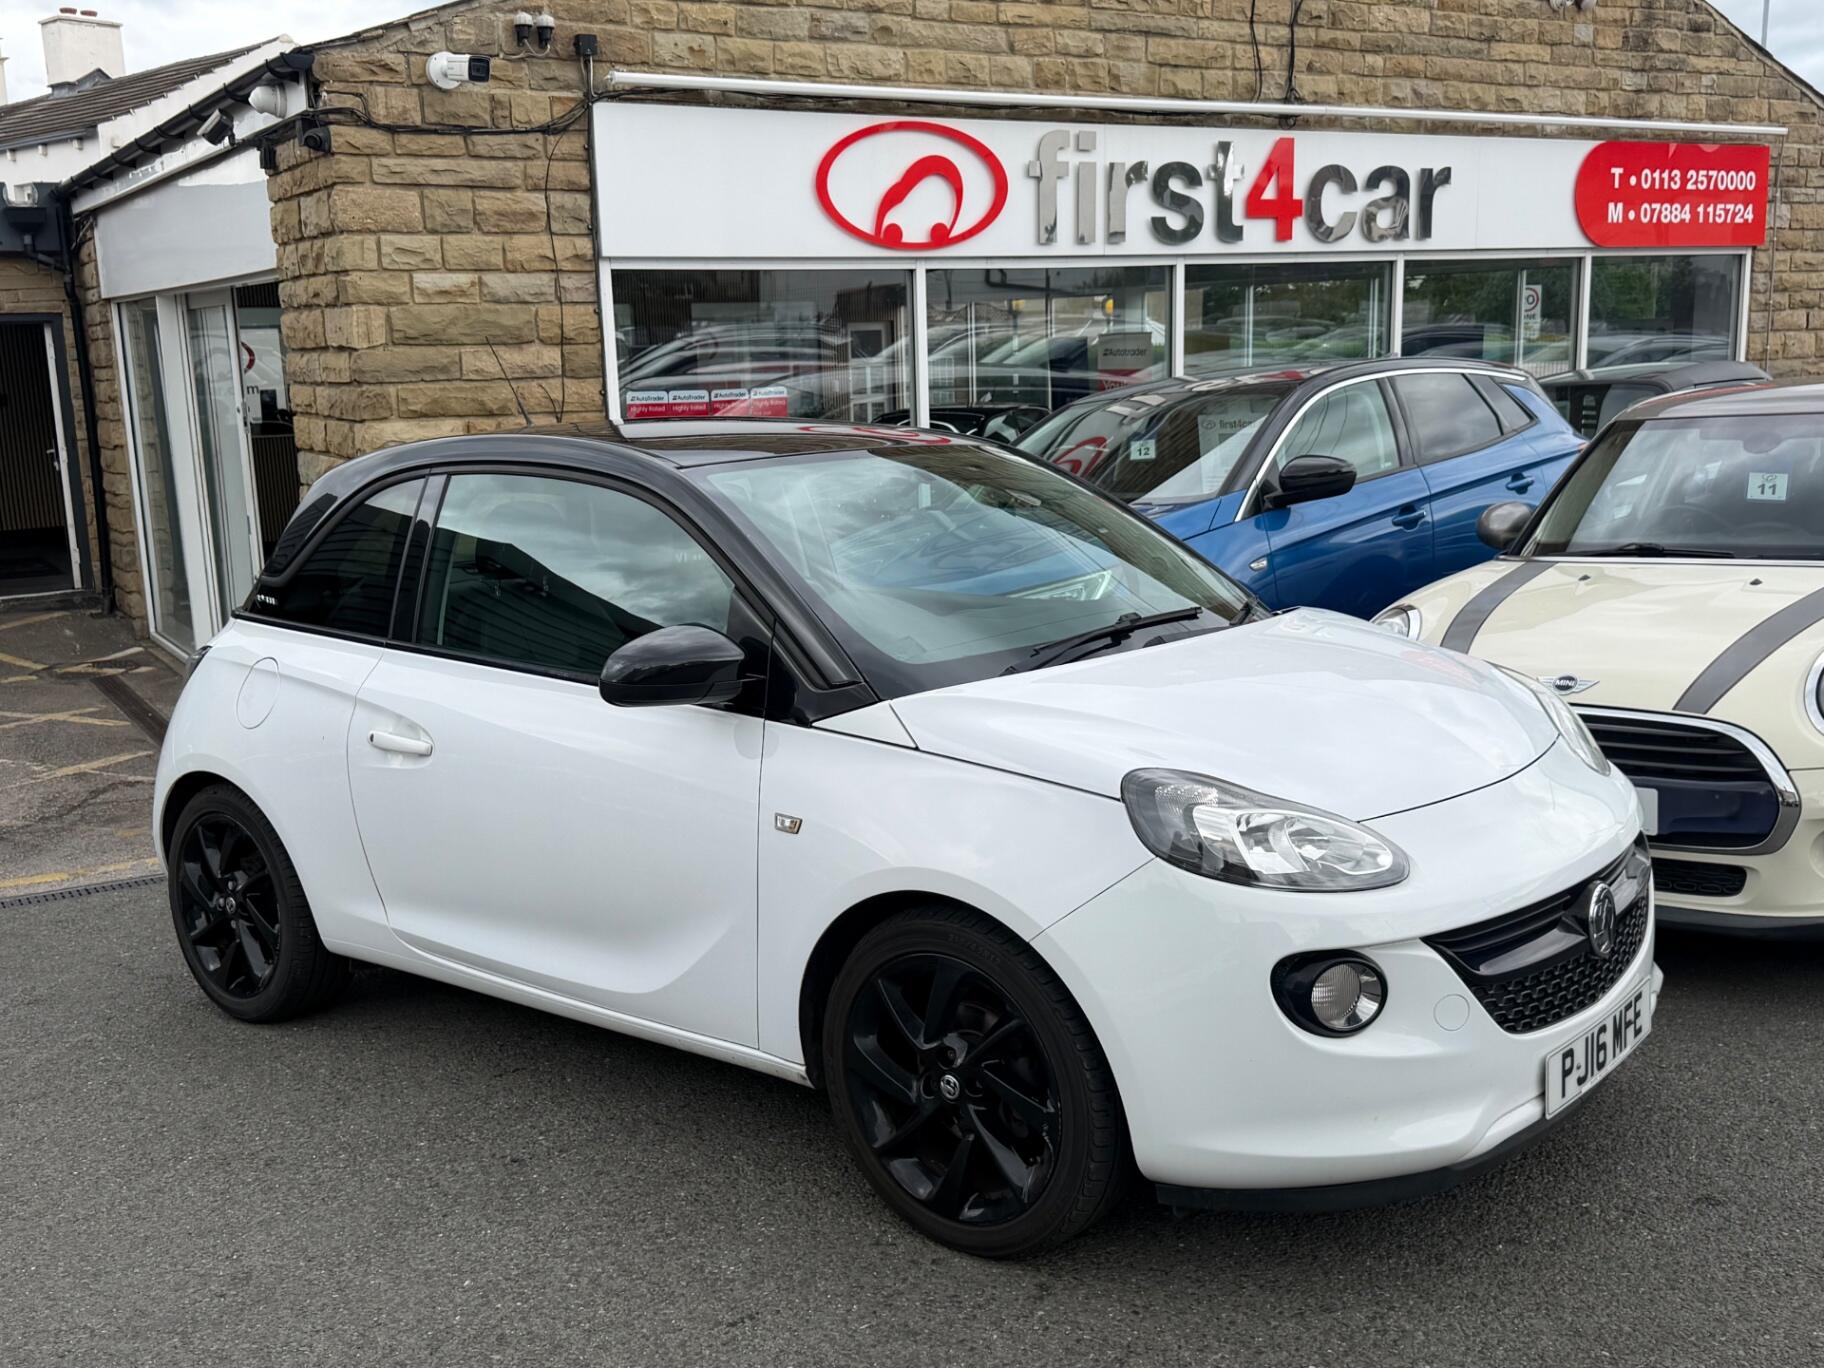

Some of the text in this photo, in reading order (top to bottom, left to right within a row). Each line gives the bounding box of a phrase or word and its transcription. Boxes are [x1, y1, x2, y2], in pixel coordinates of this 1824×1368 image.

[1028, 129, 1452, 245] first4car
[1611, 167, 1756, 191] T 0113 2570000
[1607, 202, 1753, 224] M 07884 115724
[1137, 447, 1150, 457] 12
[1757, 483, 1777, 496] 11
[1554, 679, 1576, 687] MINI
[1561, 990, 1643, 1099] PJ16 MFE
